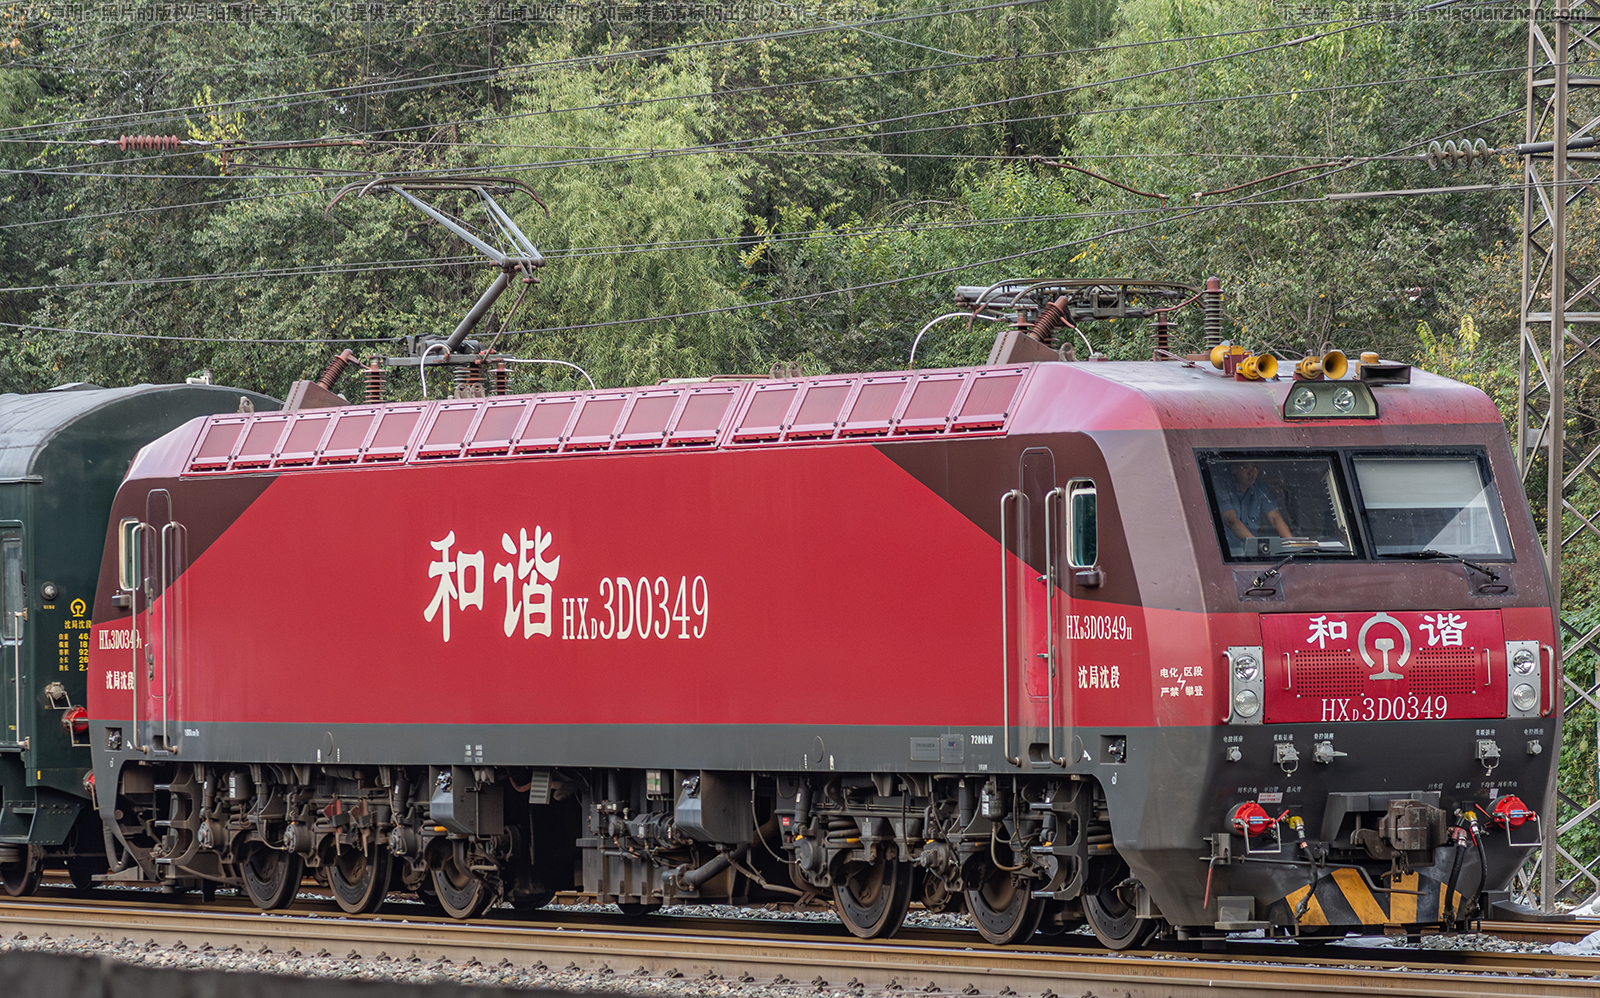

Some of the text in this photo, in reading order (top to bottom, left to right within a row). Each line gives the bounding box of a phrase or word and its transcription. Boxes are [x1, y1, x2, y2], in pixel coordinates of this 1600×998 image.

[424, 525, 560, 642] 和谐
[1078, 665, 1120, 689] 沈局沈段
[1160, 666, 1203, 678] 电化 区段
[1160, 686, 1180, 698] 严禁
